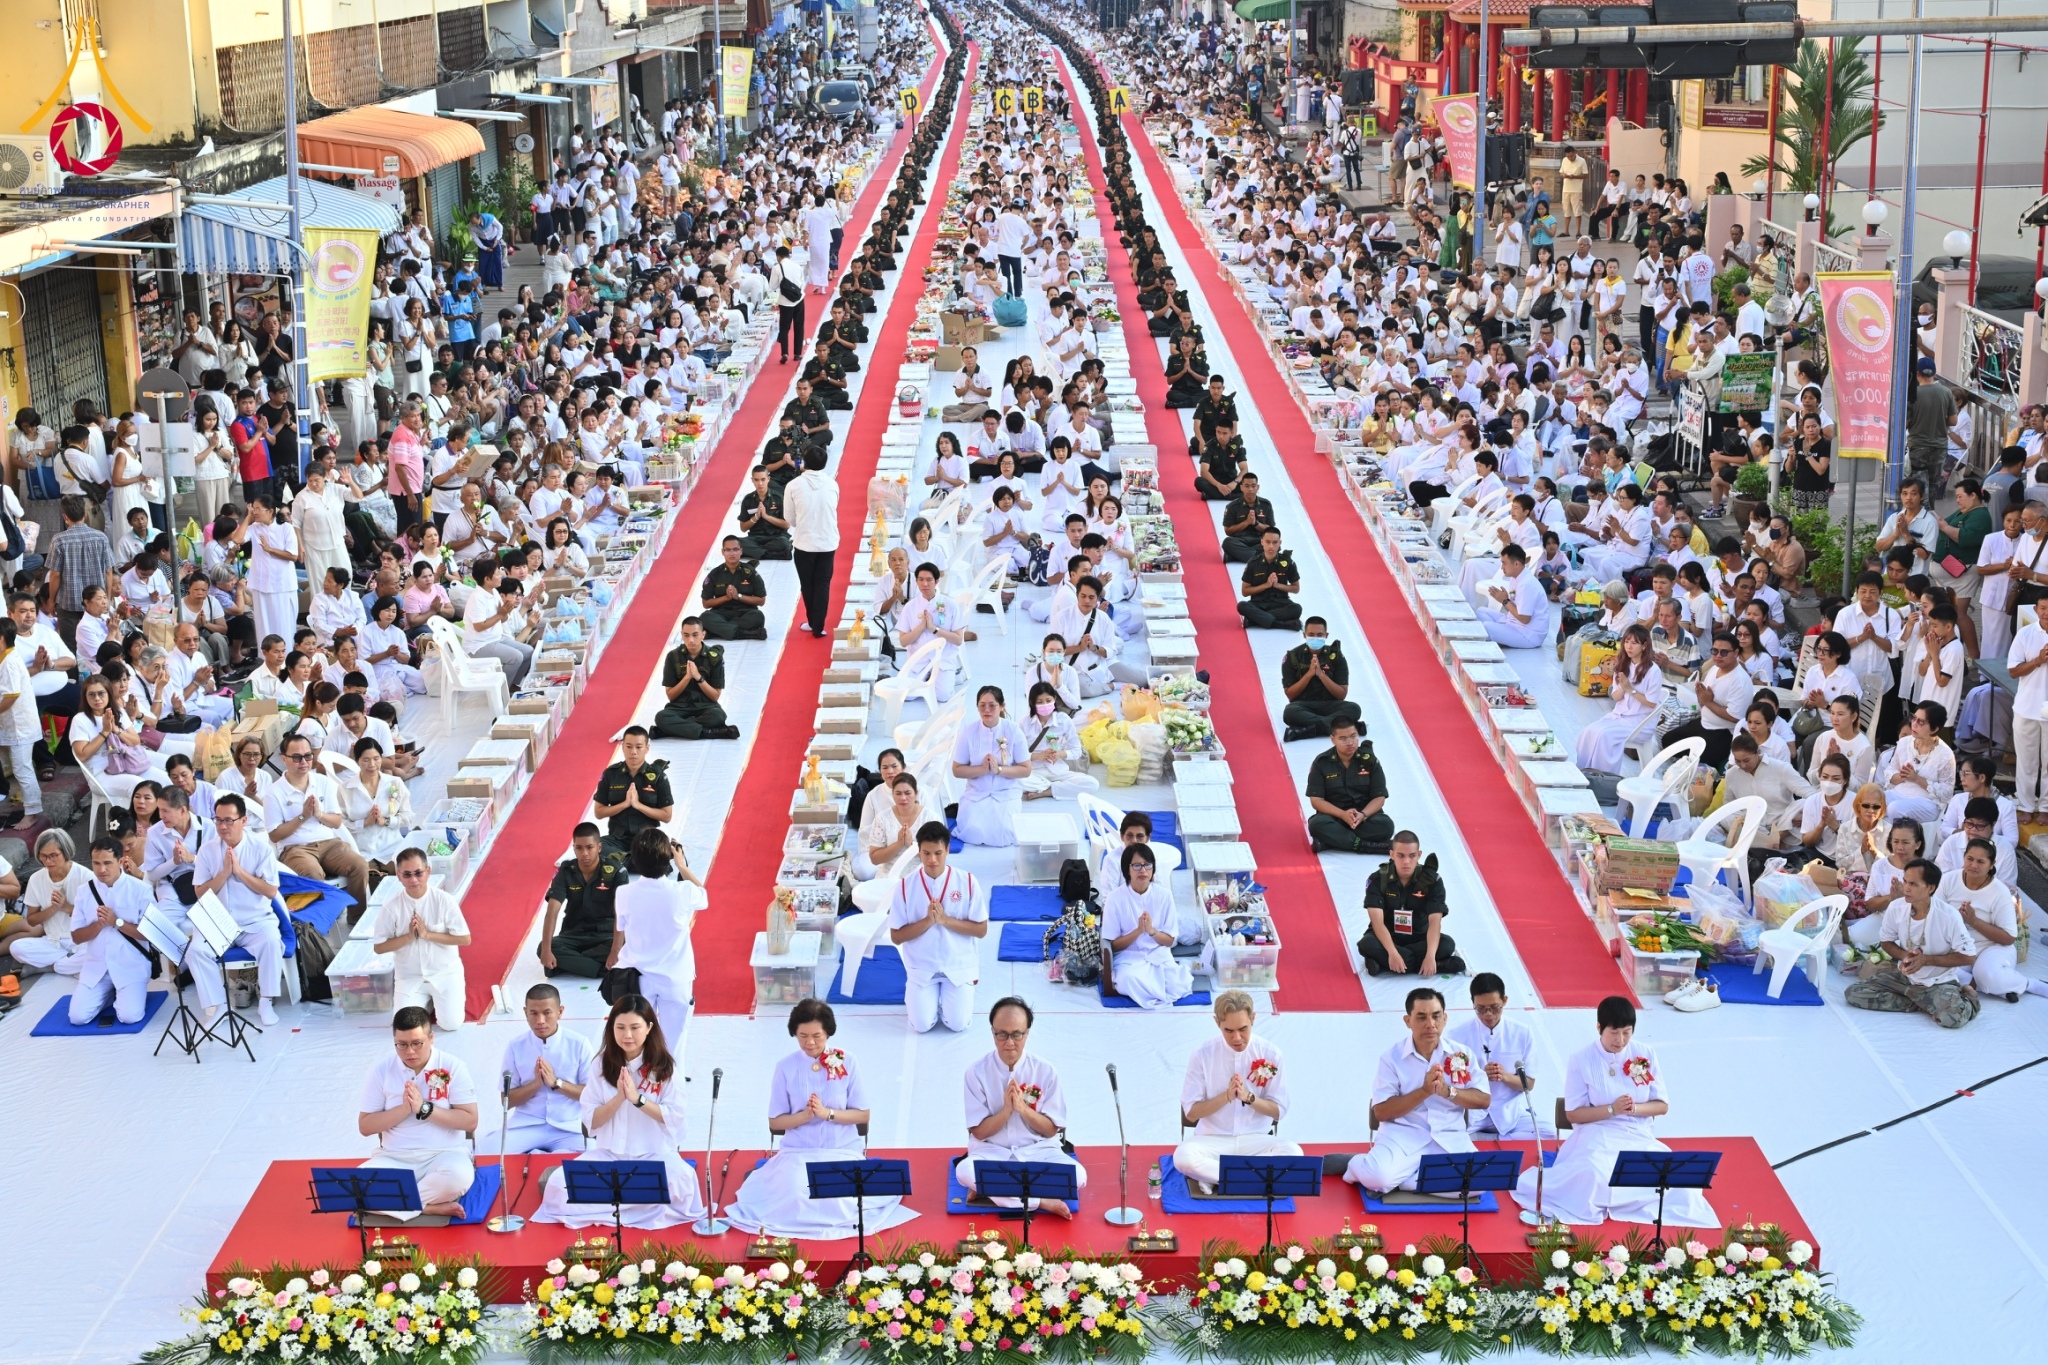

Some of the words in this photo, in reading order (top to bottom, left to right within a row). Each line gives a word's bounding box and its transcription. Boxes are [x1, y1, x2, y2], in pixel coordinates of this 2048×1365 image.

[903, 91, 917, 110] D
[999, 94, 1011, 111] C
[1027, 92, 1040, 109] B
[1113, 92, 1126, 109] A
[357, 178, 397, 191] Massage
[374, 190, 381, 198] &
